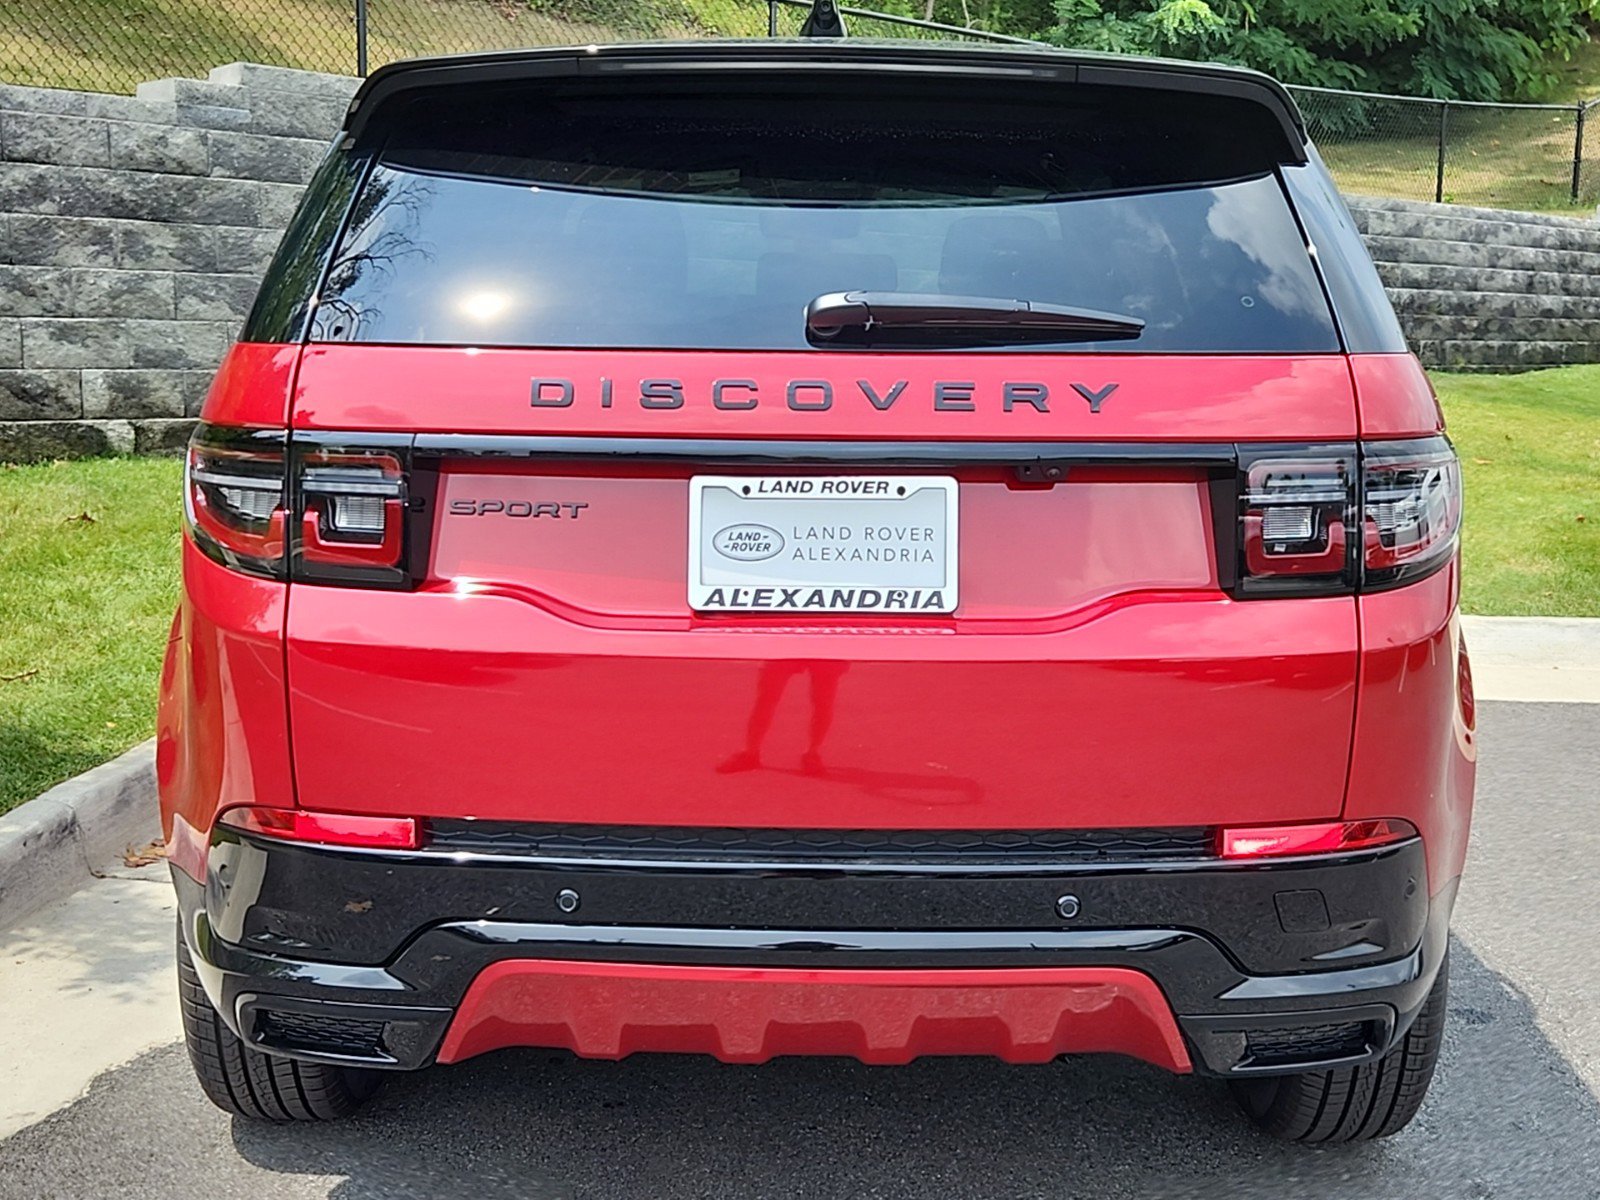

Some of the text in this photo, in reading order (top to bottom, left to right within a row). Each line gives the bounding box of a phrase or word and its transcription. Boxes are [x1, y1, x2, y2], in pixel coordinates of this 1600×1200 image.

[530, 378, 1120, 413] DISCOVERY
[757, 480, 890, 495] LAND ROVER
[449, 499, 589, 519] SPORT
[793, 526, 935, 542] LAND ROVER
[791, 547, 935, 562] ALEXANDRIA
[702, 588, 945, 609] ALEXANDRIA
